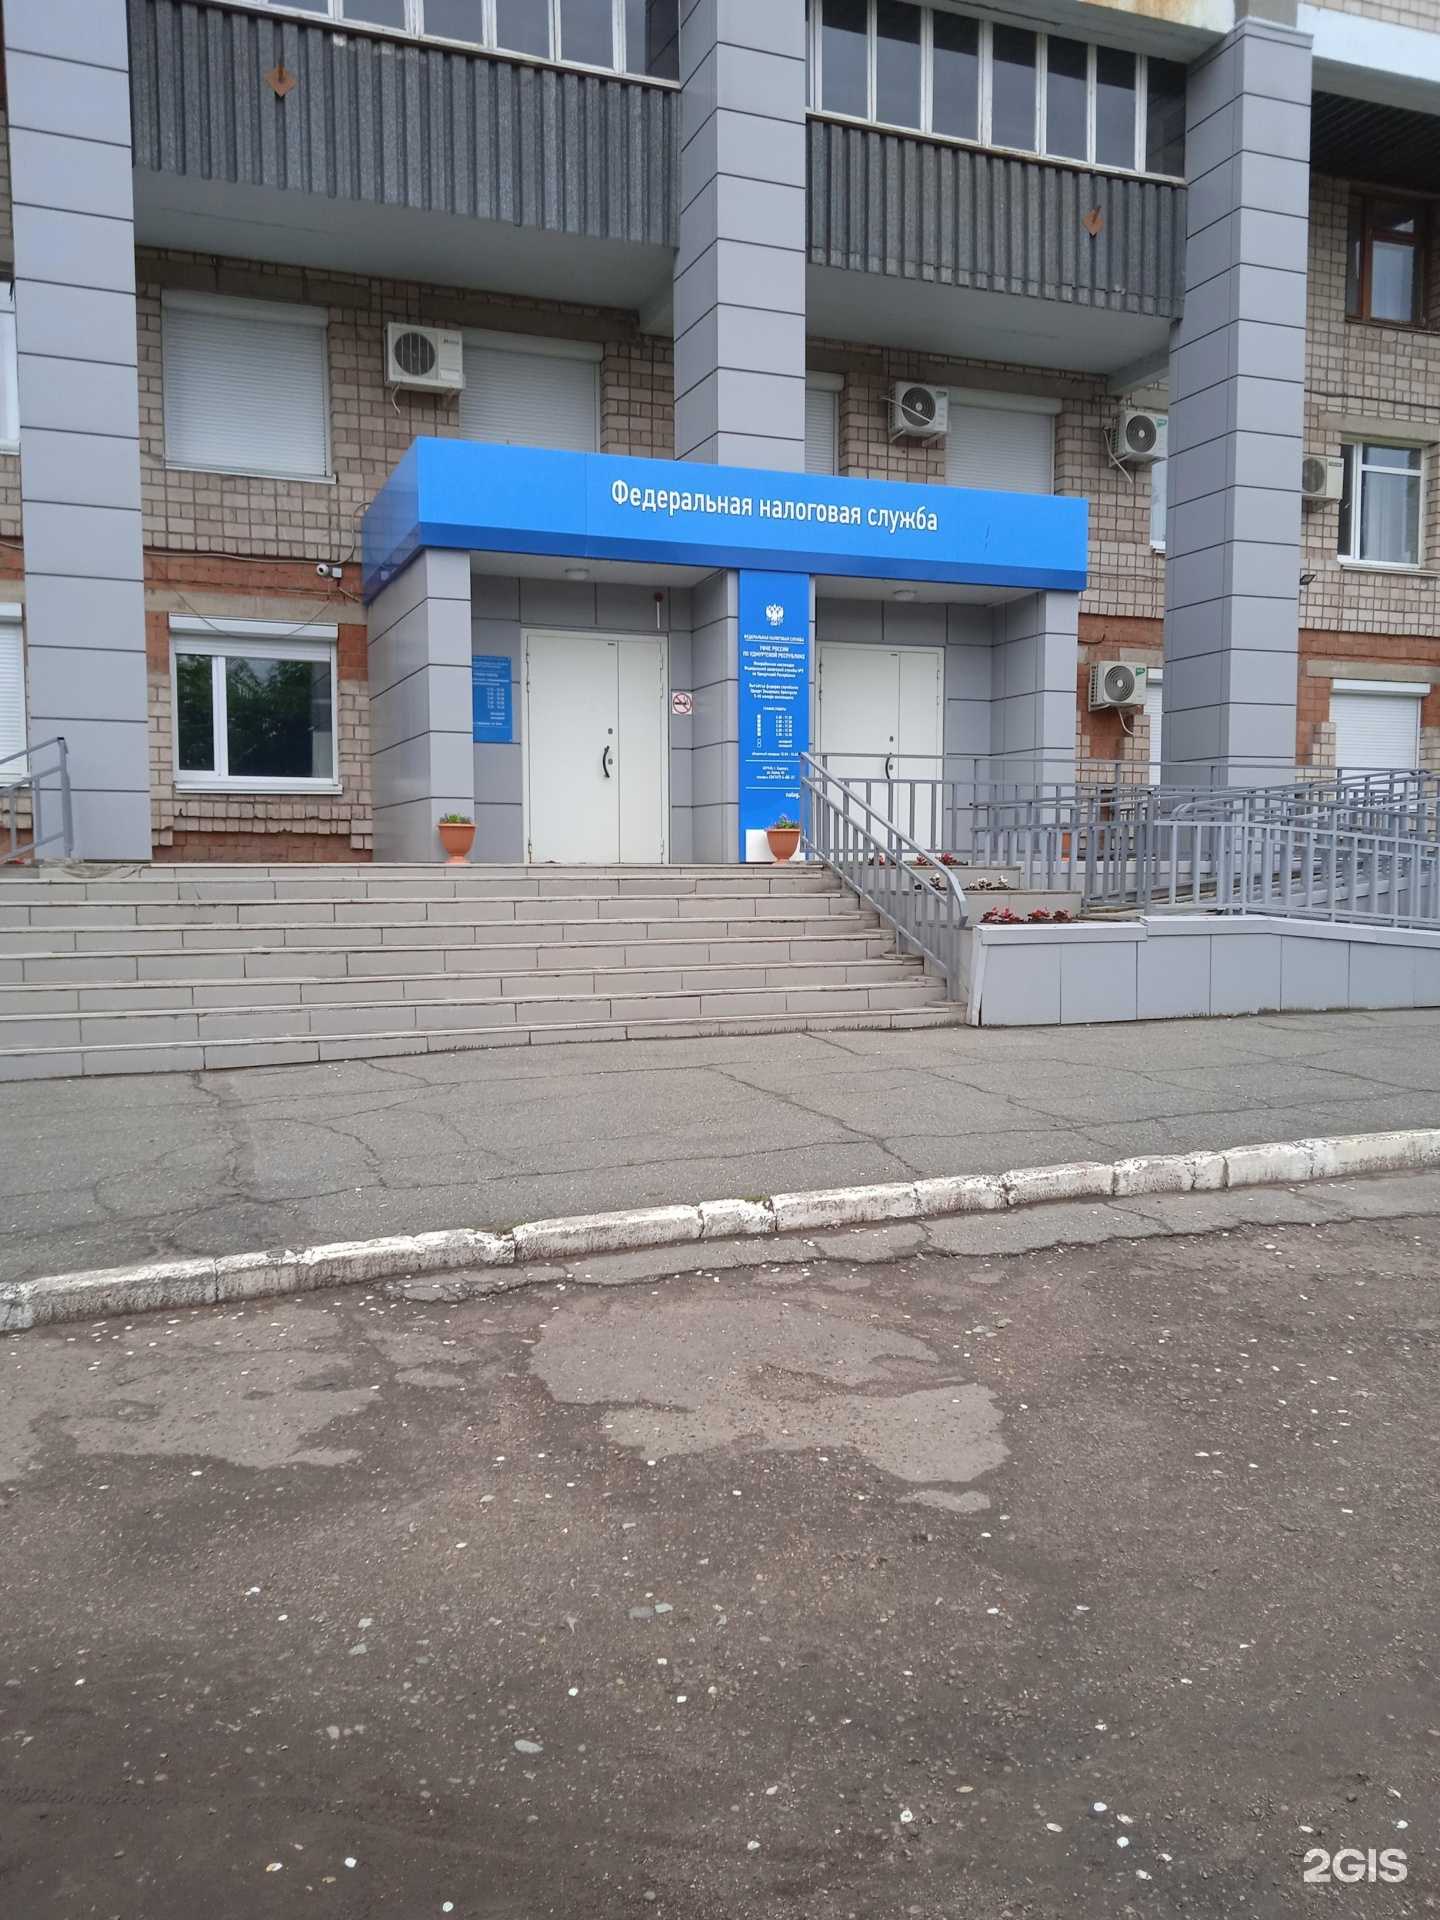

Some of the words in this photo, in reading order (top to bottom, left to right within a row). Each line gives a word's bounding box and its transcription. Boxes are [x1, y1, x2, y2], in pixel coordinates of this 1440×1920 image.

[611, 479, 752, 516] Федеральная
[758, 497, 861, 525] налоговая
[867, 504, 938, 534] служба
